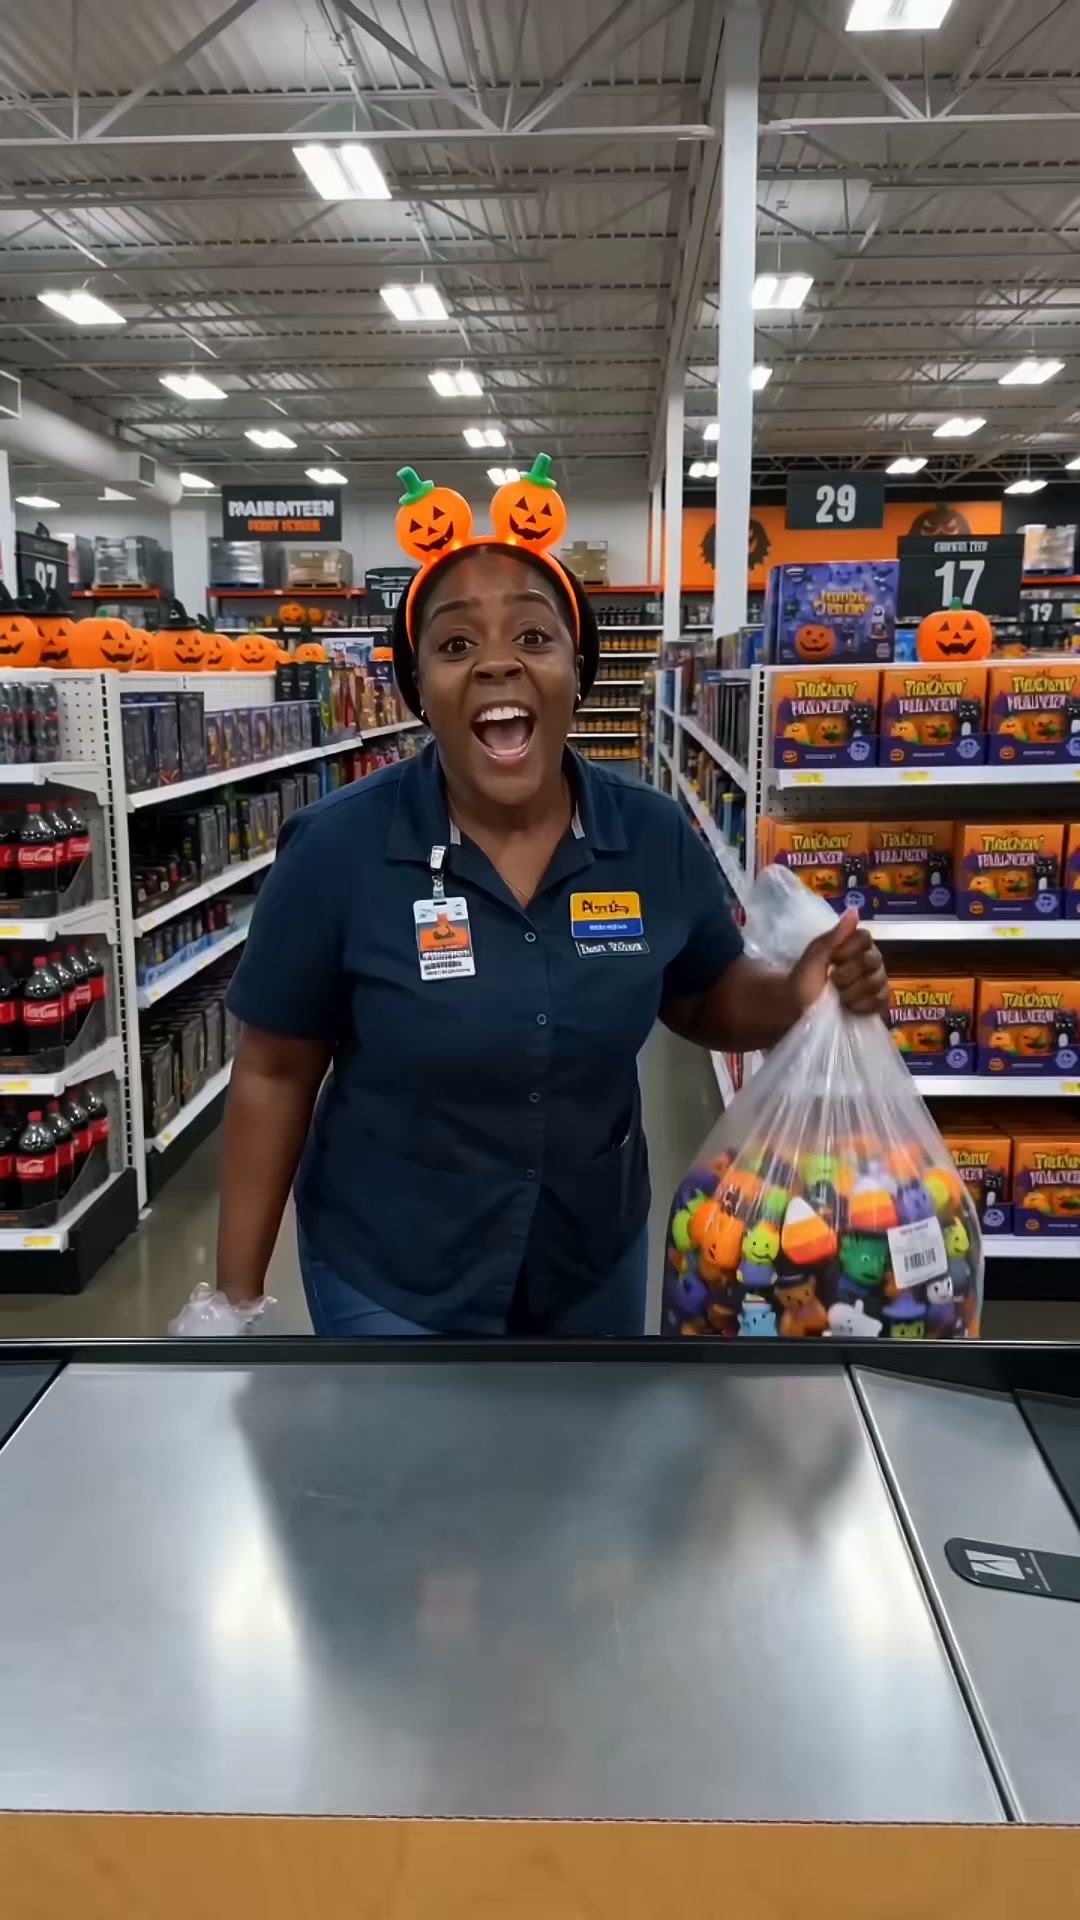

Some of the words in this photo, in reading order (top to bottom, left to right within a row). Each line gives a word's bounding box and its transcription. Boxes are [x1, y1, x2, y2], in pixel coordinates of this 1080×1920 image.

[816, 484, 857, 523] 29
[934, 560, 985, 607] 17
[1029, 602, 1054, 622] 19
